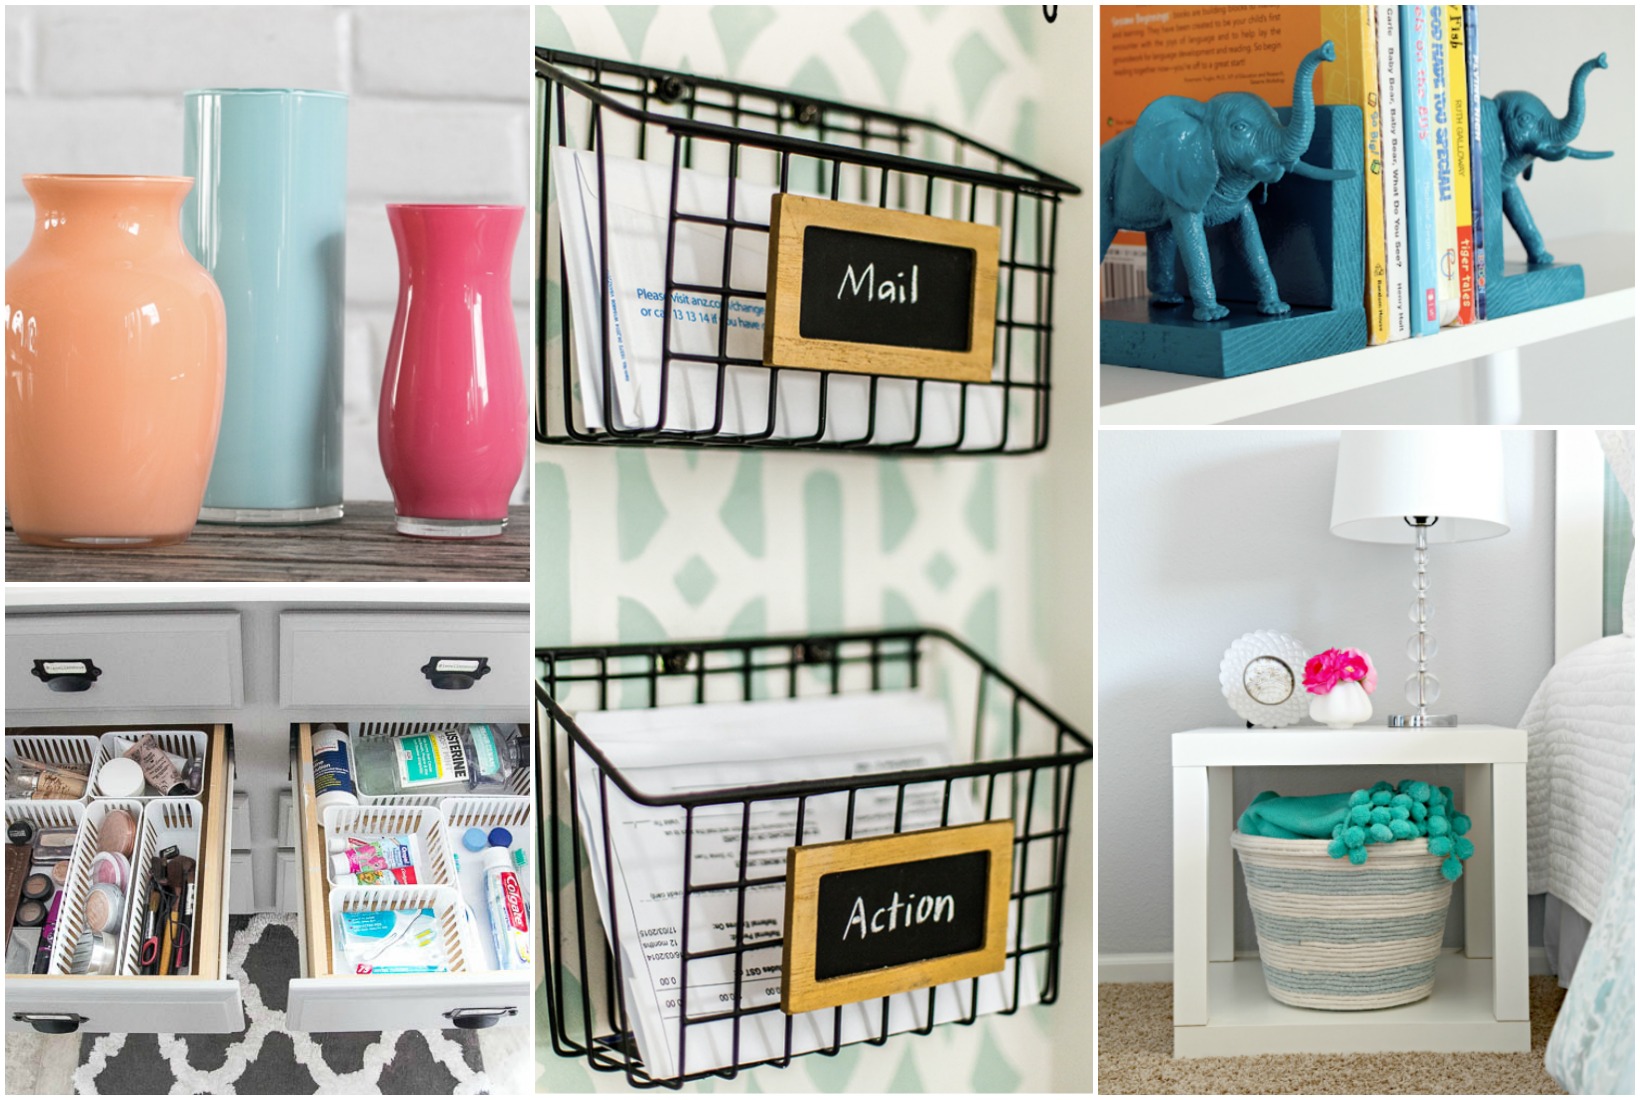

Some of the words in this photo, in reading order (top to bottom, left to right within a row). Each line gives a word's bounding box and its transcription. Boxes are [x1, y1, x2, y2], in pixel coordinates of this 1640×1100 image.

[1430, 6, 1443, 41] GOD
[1450, 15, 1463, 49] Fish
[1387, 47, 1395, 75] Baby
[1432, 43, 1446, 88] MADE
[1388, 77, 1396, 105] Bear,
[1434, 91, 1447, 124] YOU
[1455, 100, 1464, 125] RUTH
[1436, 128, 1452, 202] SPECIAL!
[1455, 126, 1466, 177] GALLOWAY
[1392, 169, 1401, 197] What
[1393, 200, 1401, 216] Do
[1394, 218, 1402, 239] You
[1460, 238, 1471, 272] tiger
[837, 262, 918, 304] Mail
[1396, 282, 1404, 311] Henry
[1462, 275, 1472, 308] tales
[671, 292, 690, 305] visit
[640, 308, 651, 317] or
[673, 309, 684, 320] 13
[686, 311, 697, 322] 13
[699, 312, 710, 324] 14
[711, 313, 718, 325] if
[738, 317, 761, 330] have
[506, 876, 523, 927] Colgate
[842, 891, 955, 941] Action
[639, 926, 677, 938] 17/03/2015
[642, 940, 669, 949] months
[669, 939, 678, 948] 12
[660, 976, 677, 986] 0.00
[745, 966, 762, 977] GST
